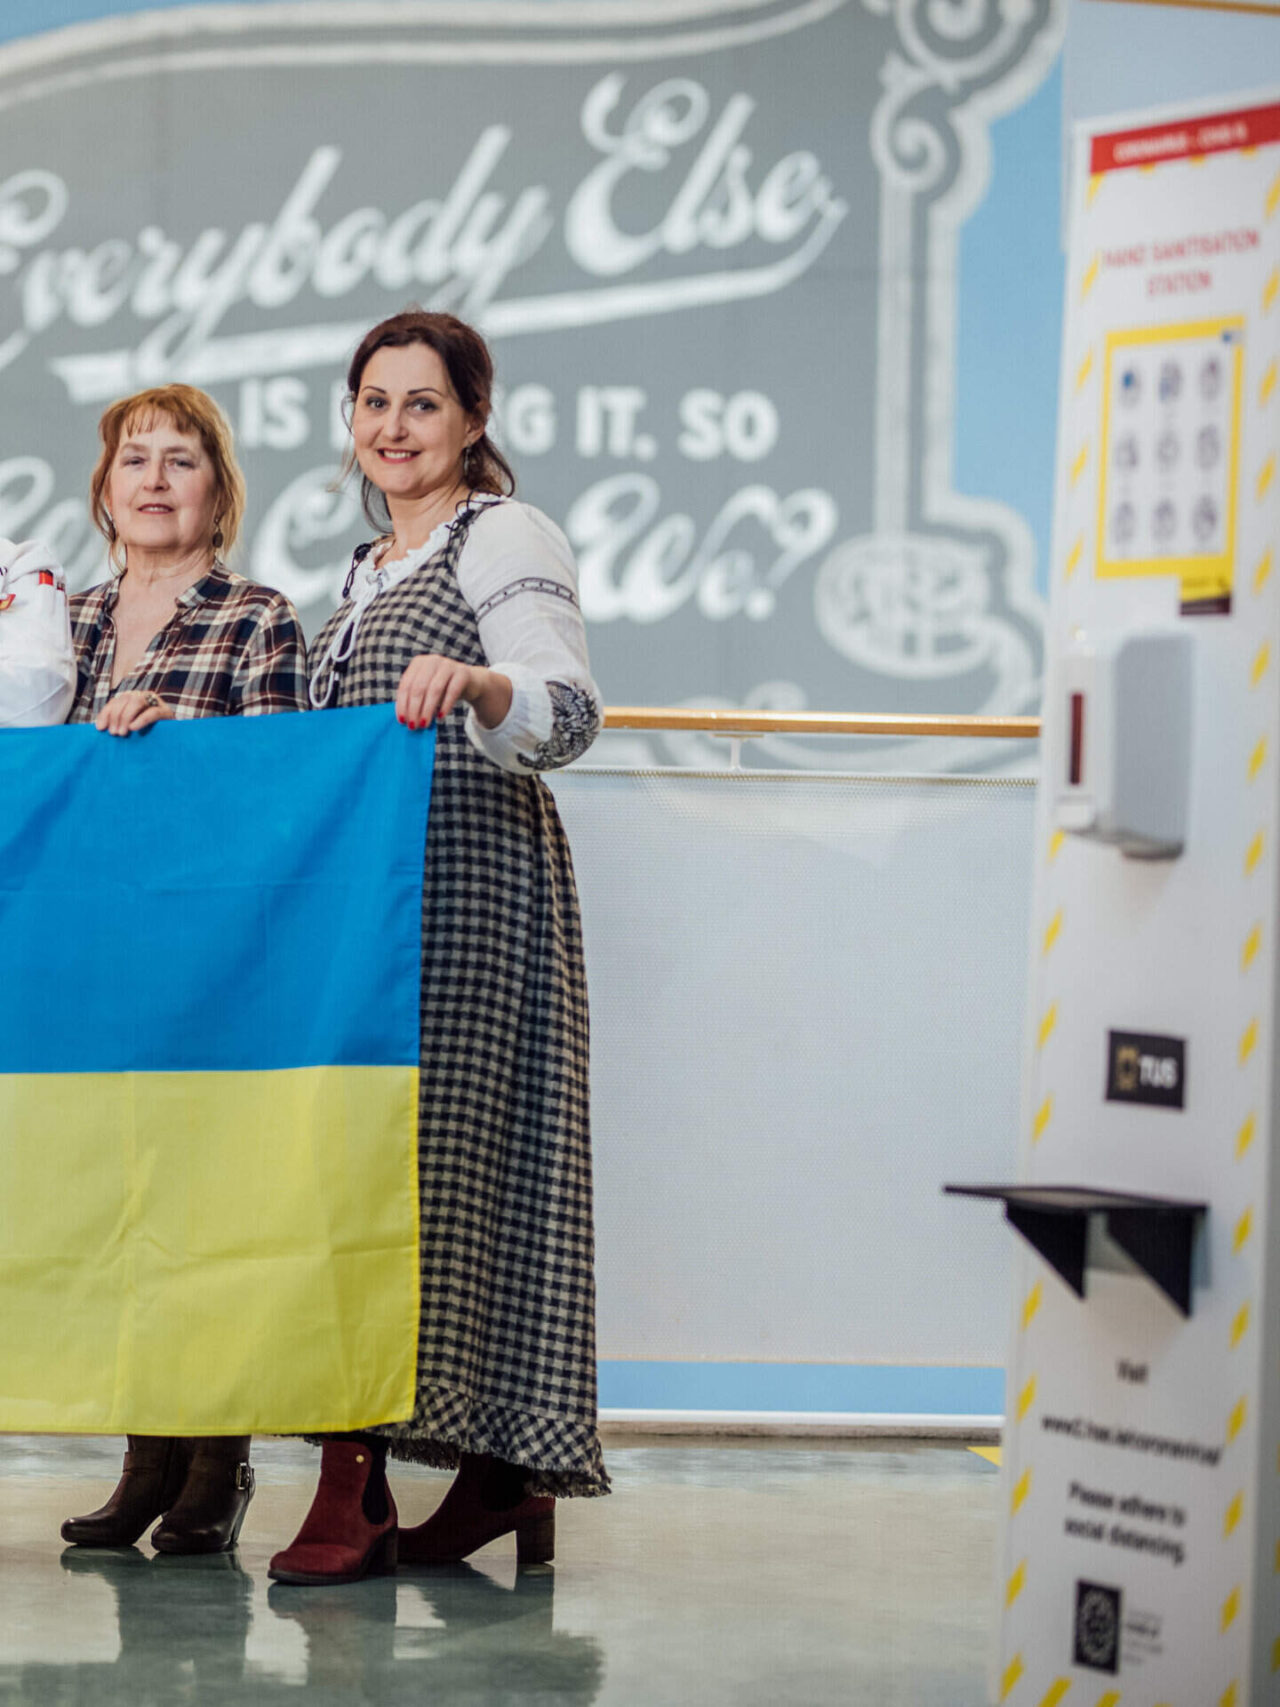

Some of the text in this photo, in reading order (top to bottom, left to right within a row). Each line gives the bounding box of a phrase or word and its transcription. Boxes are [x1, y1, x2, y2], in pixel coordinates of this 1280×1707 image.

[565, 70, 834, 277] Else
[238, 375, 311, 451] IS
[677, 386, 781, 463] SO
[566, 471, 838, 624] We?
